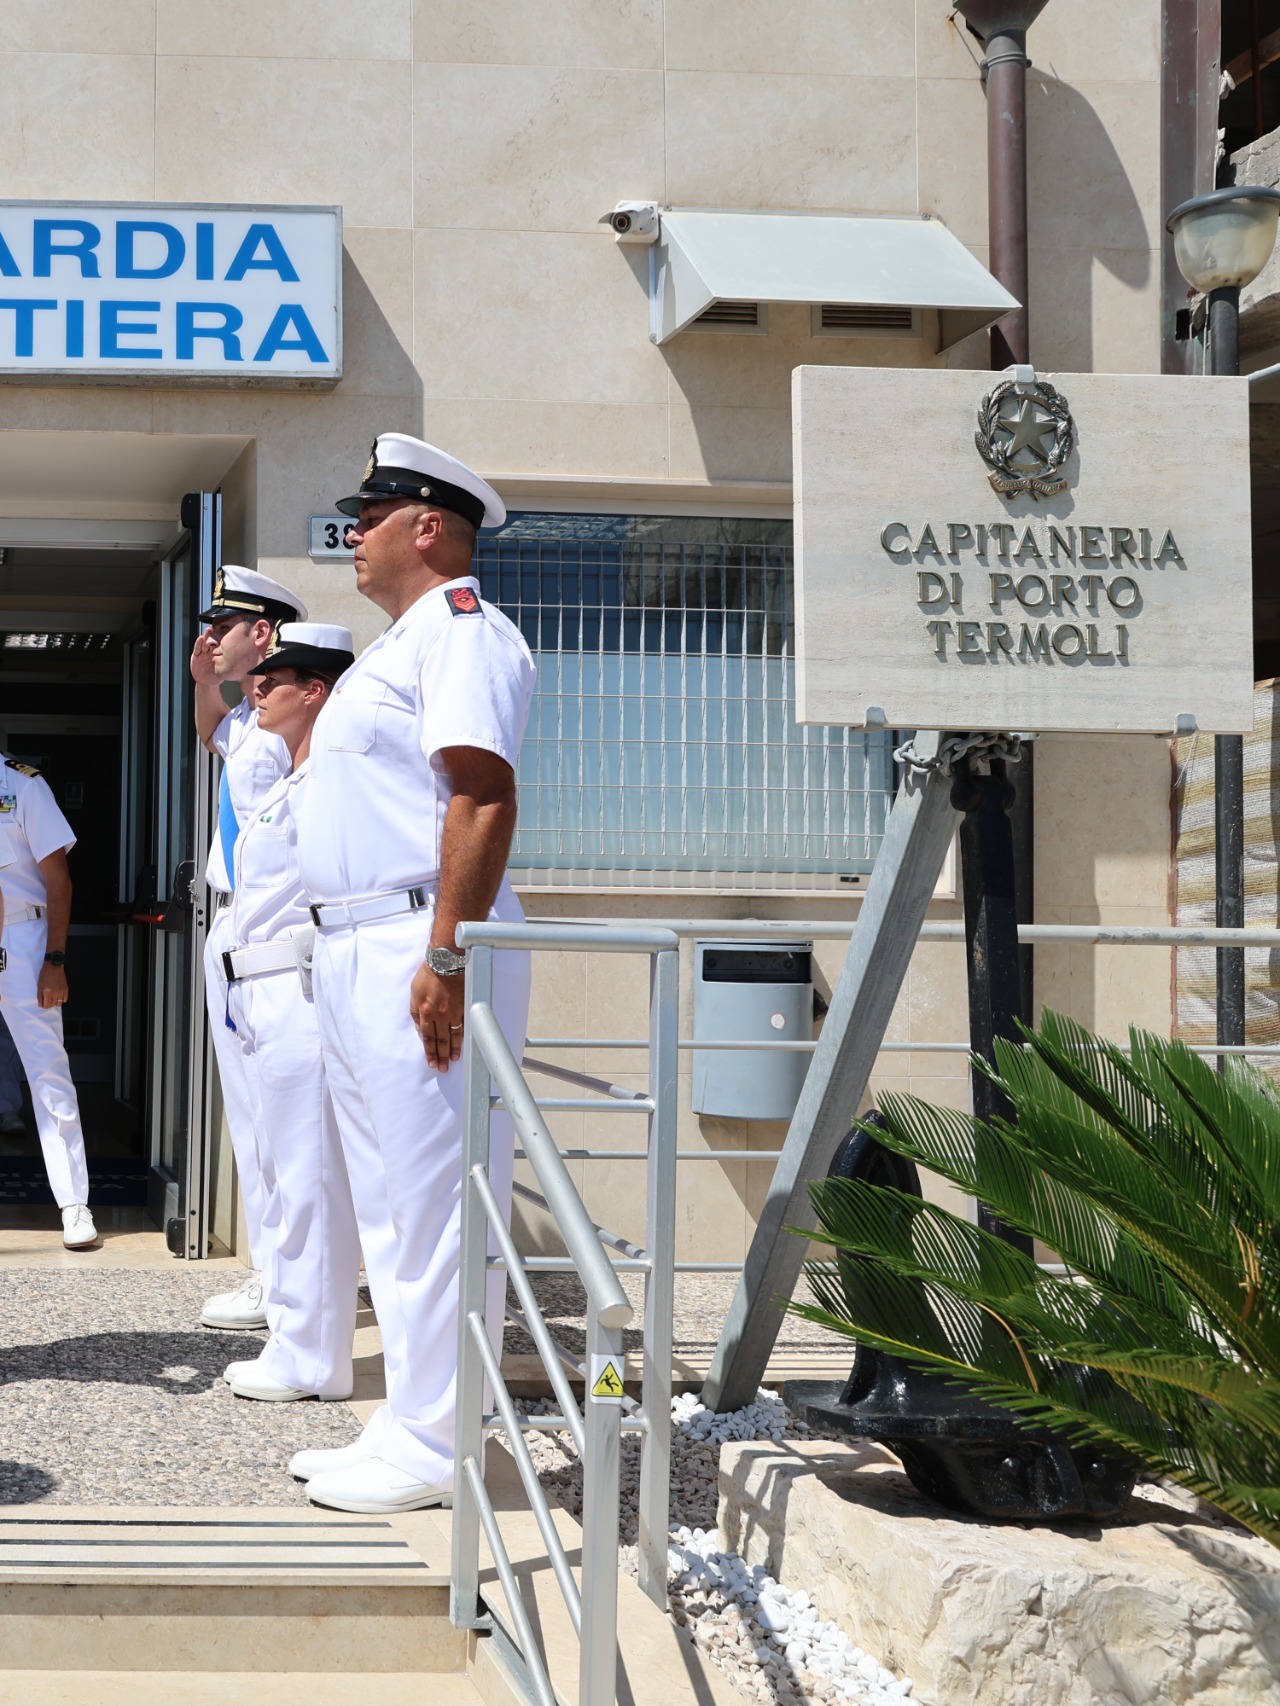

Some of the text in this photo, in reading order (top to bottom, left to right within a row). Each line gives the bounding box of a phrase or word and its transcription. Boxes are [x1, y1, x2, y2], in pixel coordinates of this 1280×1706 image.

[880, 521, 1185, 561] CAPITANERIA
[917, 571, 1140, 608] DI PORTO
[926, 620, 1126, 657] TERMOLI
